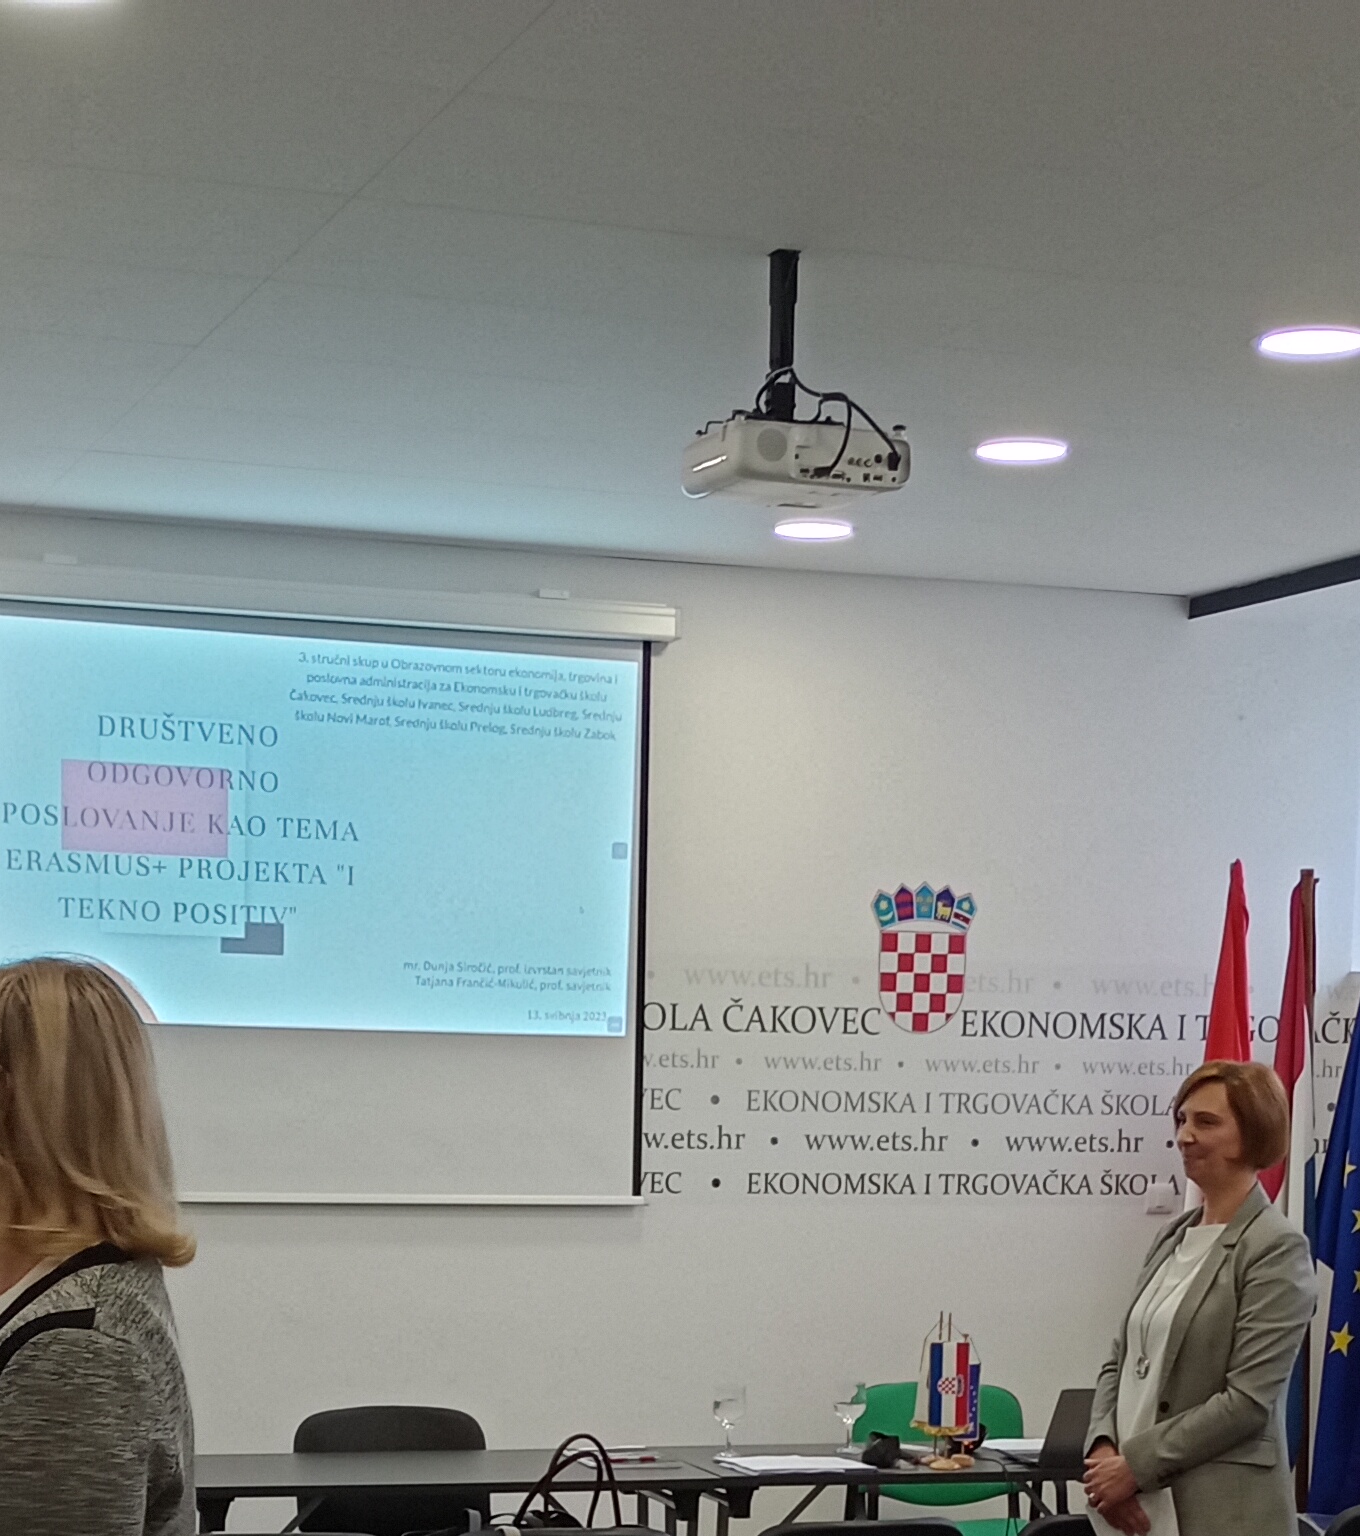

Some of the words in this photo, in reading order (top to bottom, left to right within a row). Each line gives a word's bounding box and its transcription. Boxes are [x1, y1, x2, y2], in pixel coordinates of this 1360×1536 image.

[98, 712, 279, 748] DRUŠTVENO
[88, 761, 279, 793] ODGOVORNO
[3, 802, 195, 834] POSLOVANJE
[208, 813, 266, 837] KAO
[276, 817, 360, 842] TEMA
[6, 849, 167, 878] ERASMUS+
[179, 857, 327, 885] PROJEKTA
[57, 896, 160, 922] TEKNO
[684, 964, 832, 989] www.ets.hr
[723, 997, 881, 1035] ČAKOVEC
[960, 1009, 1168, 1042] EKONOMSKA
[1177, 1014, 1187, 1041] I
[764, 1051, 882, 1072] www.ets.hr
[926, 1054, 1039, 1075] www.ets.hr
[746, 1090, 917, 1114] EKONOMSKA
[925, 1092, 932, 1113] I
[939, 1089, 1094, 1116] TRGOVAČKA
[804, 1127, 948, 1152] www.ets.hr
[1005, 1129, 1144, 1153] www.ets.hr
[746, 1172, 918, 1196] EKONOMSKA
[924, 1173, 932, 1196] I
[939, 1169, 1093, 1196] TRGOVAČKA
